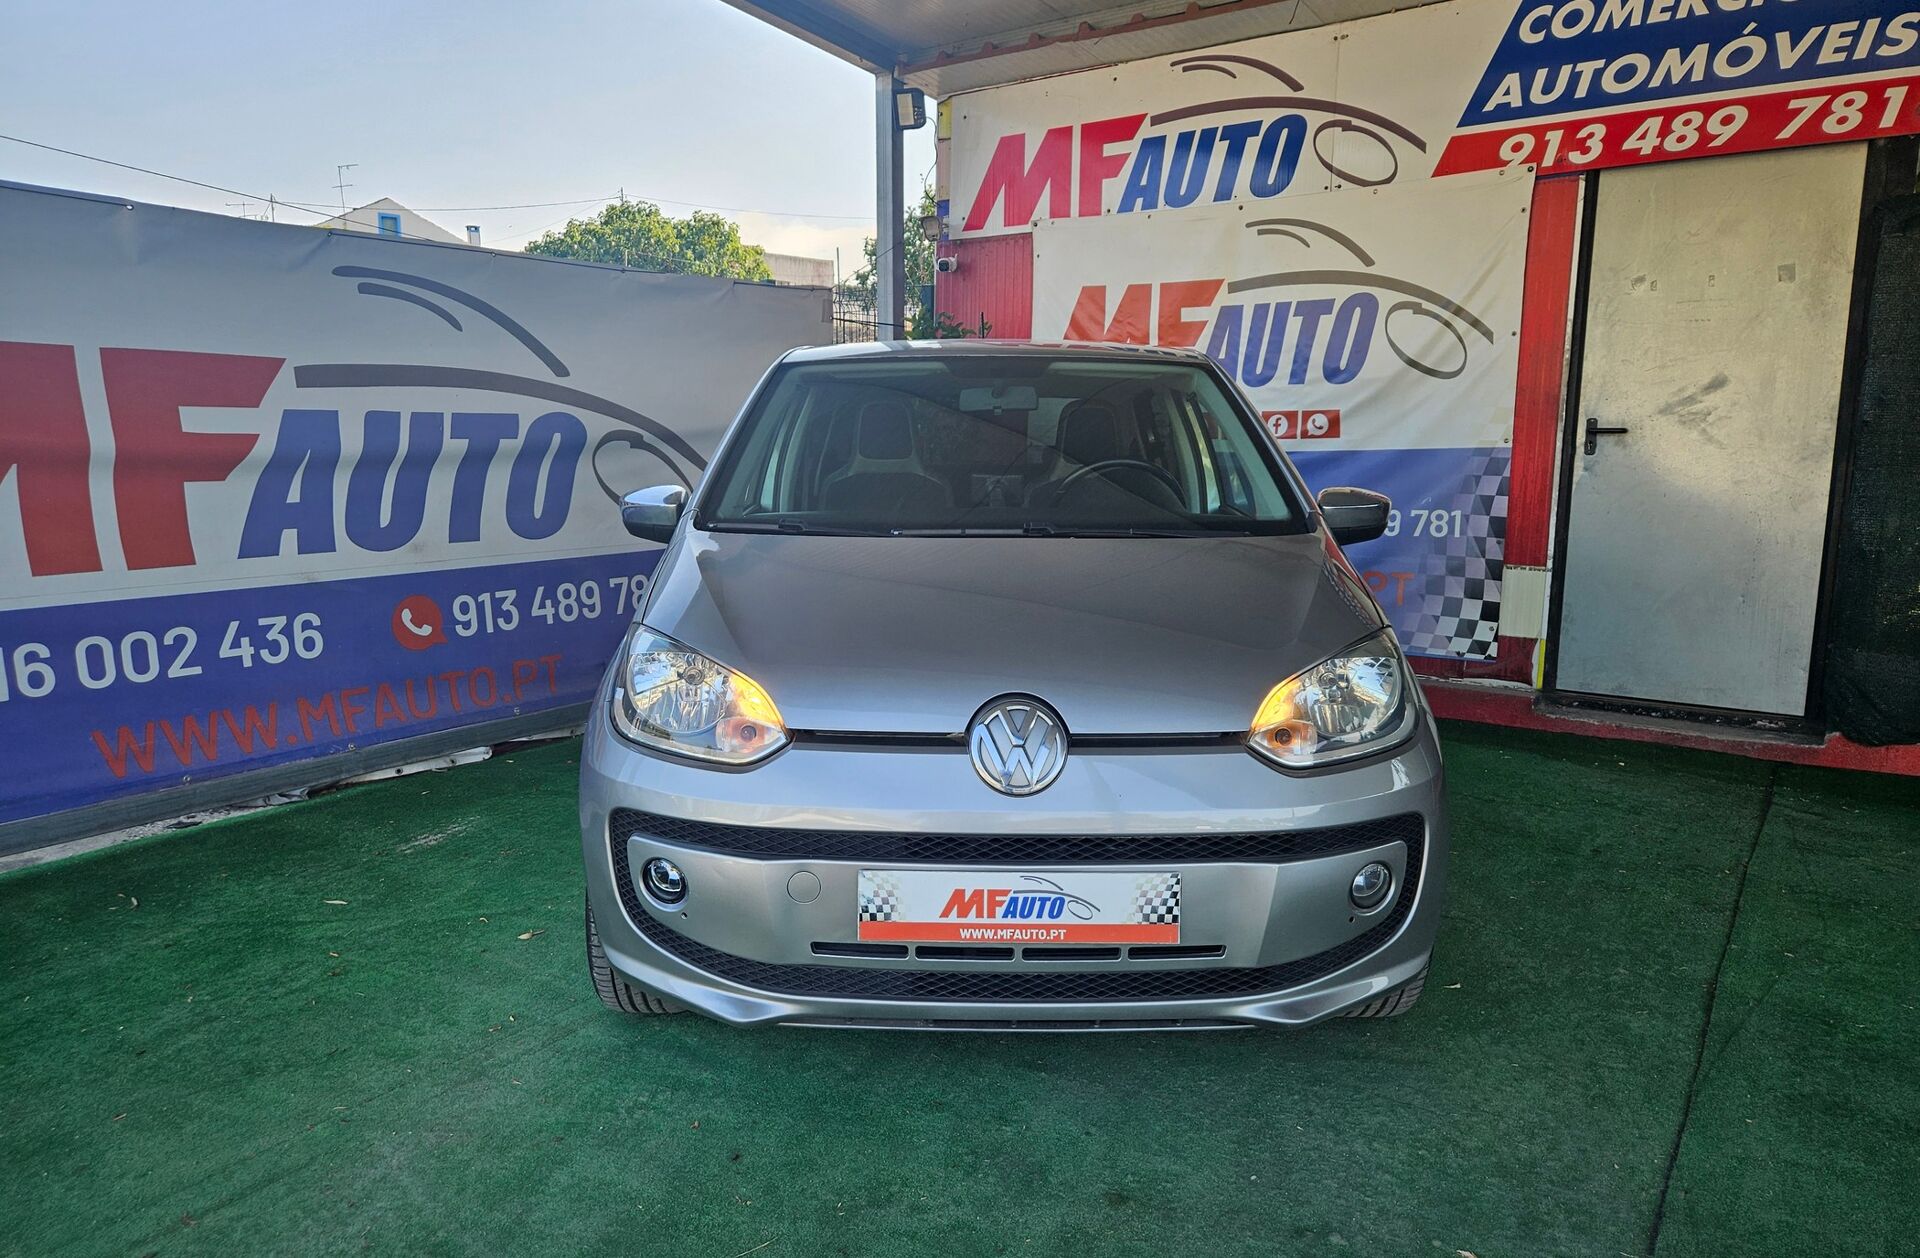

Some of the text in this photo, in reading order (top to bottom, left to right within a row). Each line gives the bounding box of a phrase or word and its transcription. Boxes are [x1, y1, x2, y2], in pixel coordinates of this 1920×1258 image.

[1483, 11, 1920, 112] AUTOMÓVEIS
[1499, 85, 1909, 168] 913 489 781
[1410, 509, 1462, 538] 781
[75, 626, 203, 689] 002
[219, 612, 324, 668] 436
[453, 589, 520, 637] 913
[531, 580, 602, 625] 489
[91, 655, 562, 778] WWW.MFAUTO.PT
[959, 928, 1067, 941] WWW.MFAUTO.PT
